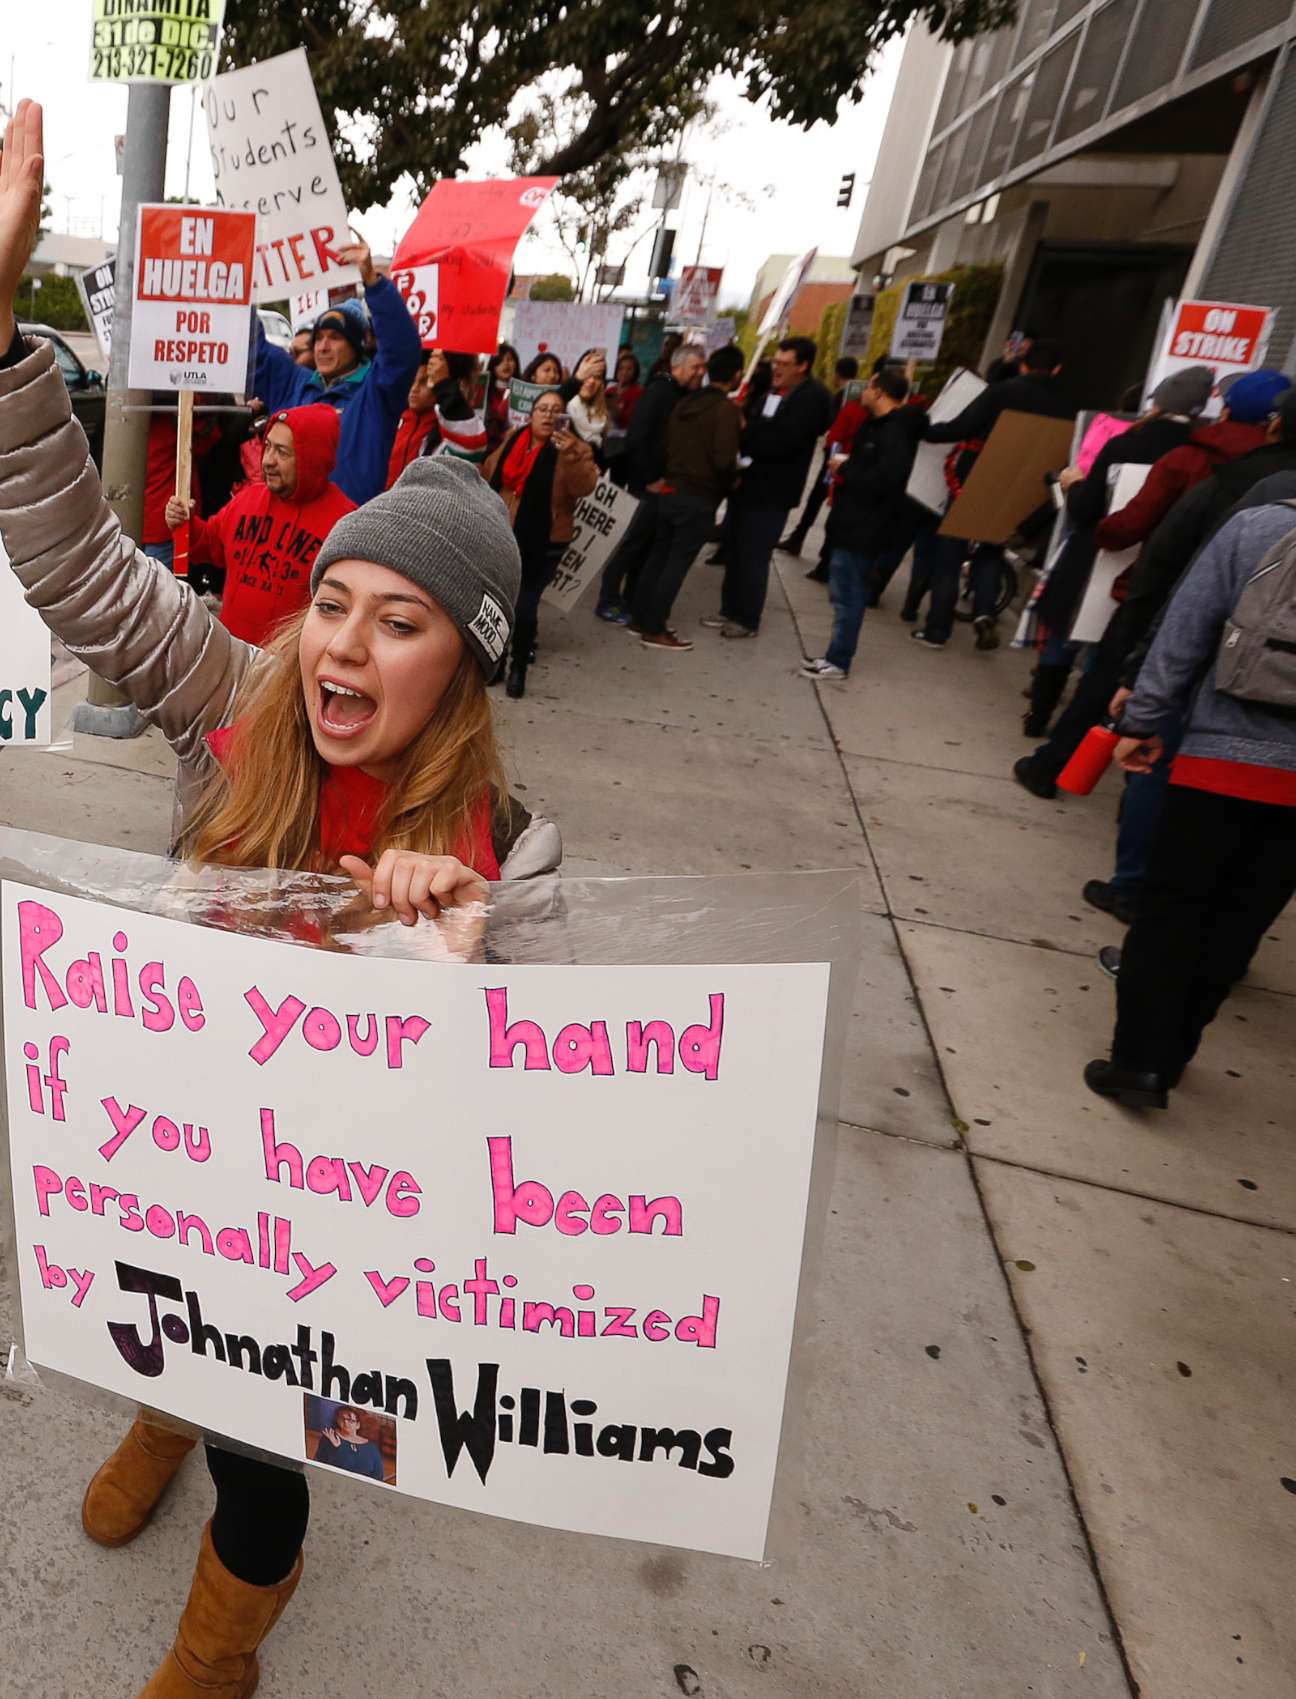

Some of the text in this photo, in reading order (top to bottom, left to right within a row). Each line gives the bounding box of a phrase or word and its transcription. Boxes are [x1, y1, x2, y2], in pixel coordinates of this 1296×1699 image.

[180, 216, 214, 256] EN
[95, 264, 114, 289] ON
[253, 226, 350, 288] TTER
[142, 258, 245, 300] HUELGA
[176, 310, 210, 334] POR
[1204, 308, 1238, 333] ON
[154, 339, 229, 365] RESPETO
[1175, 331, 1250, 361] STRIKE
[183, 371, 207, 379] UTLA
[17, 900, 725, 1081] Raise your hand
[24, 1035, 684, 1236] if you have been
[33, 1164, 721, 1348] personally victimized
[34, 1244, 735, 1487] by Johnathan Williams
